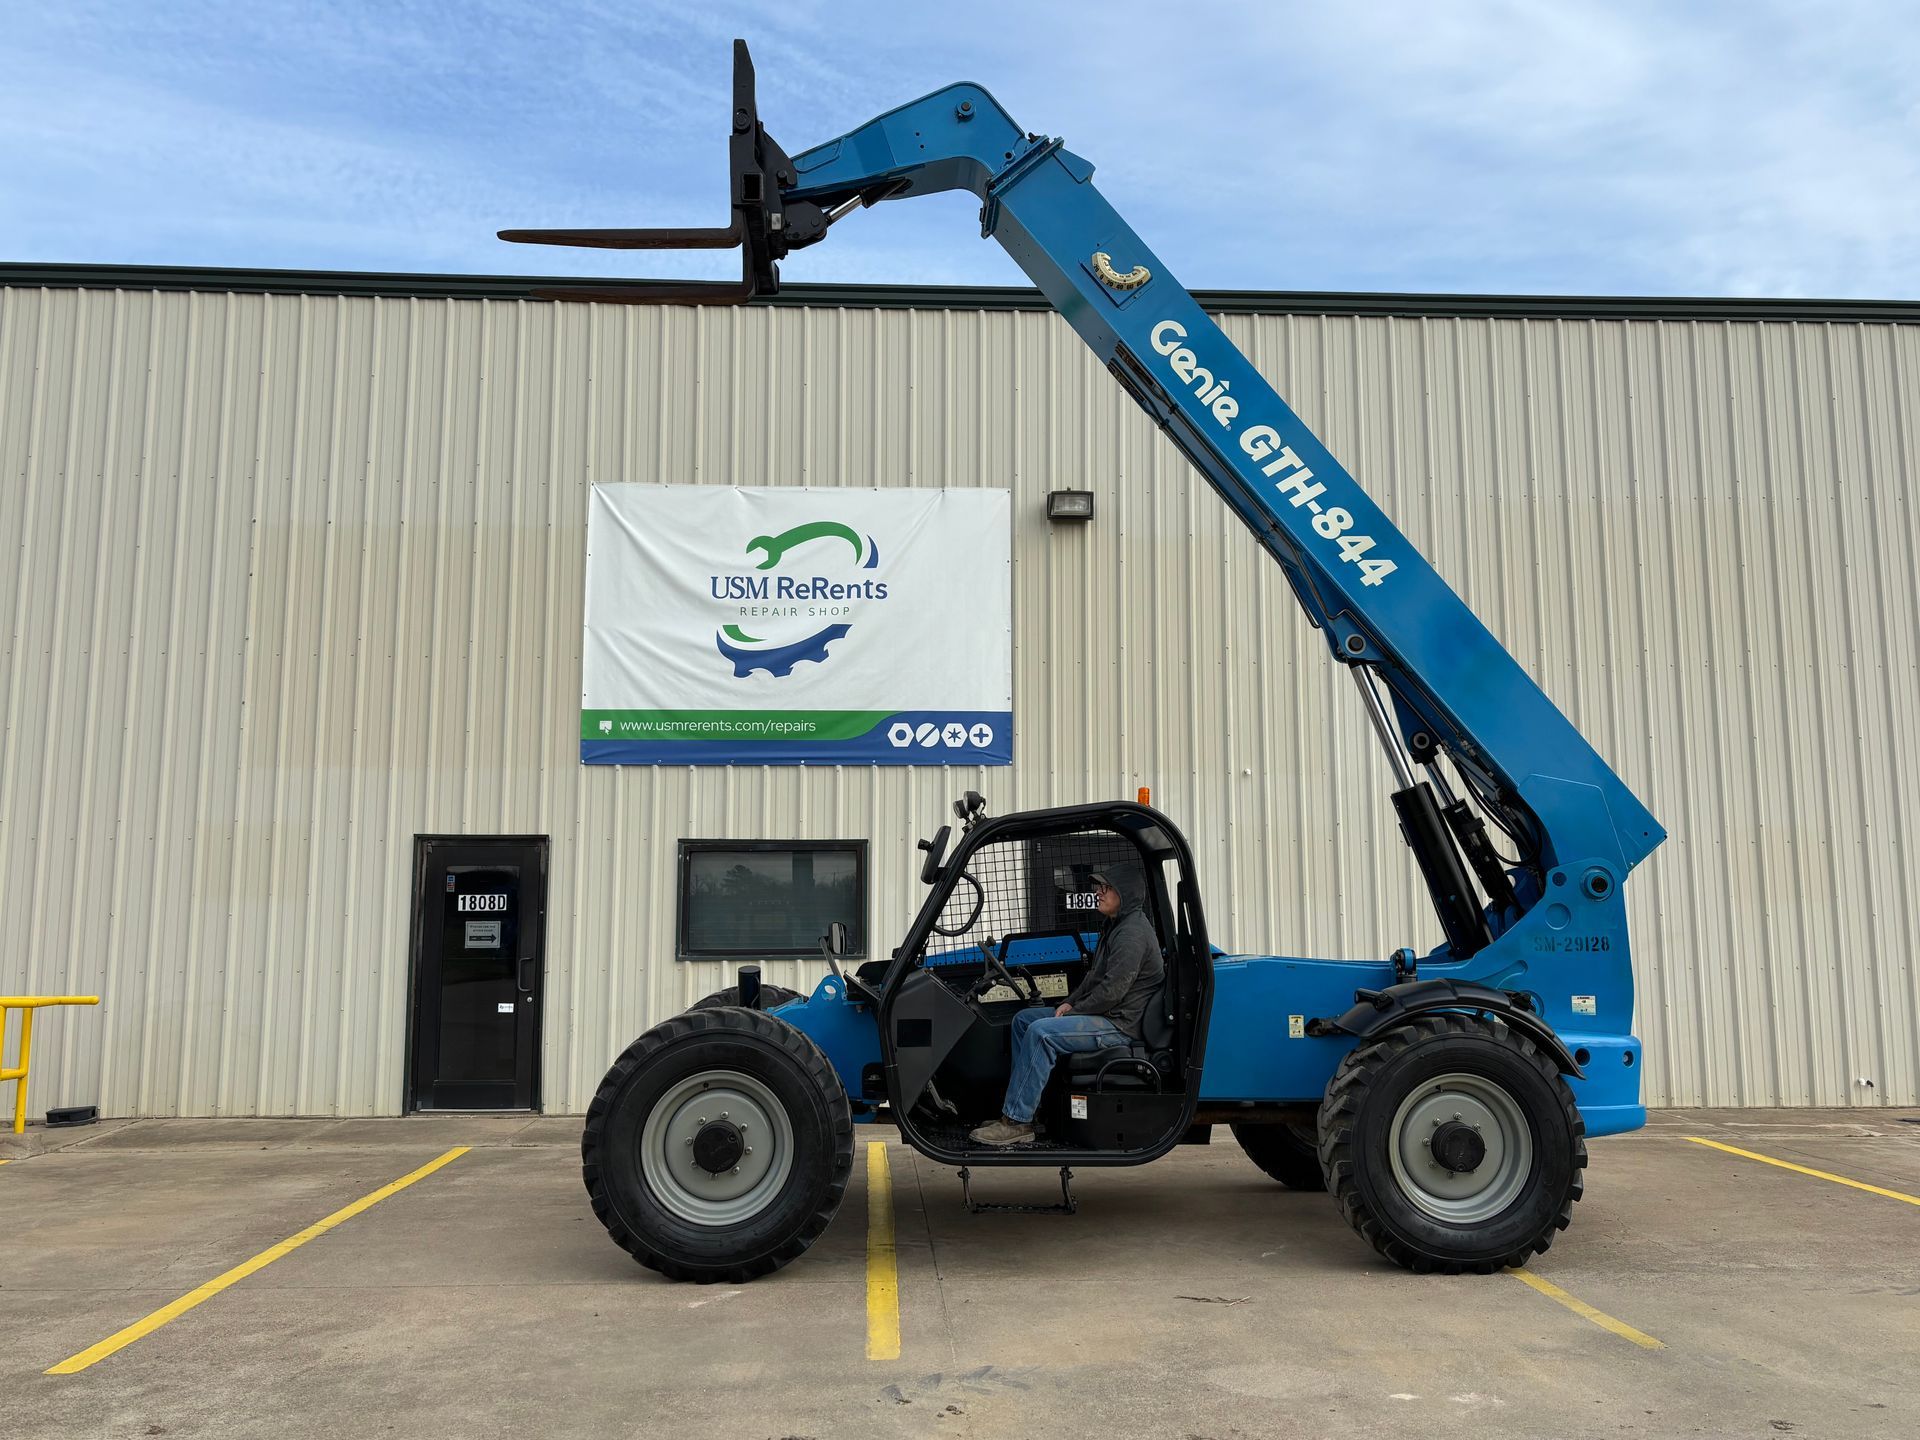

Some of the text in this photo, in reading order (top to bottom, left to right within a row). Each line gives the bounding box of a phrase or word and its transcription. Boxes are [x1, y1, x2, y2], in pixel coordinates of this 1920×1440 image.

[1150, 320, 1398, 587] Genie GTH-844
[711, 576, 888, 600] USM ReRents
[740, 606, 850, 617] REPAIR SHOP
[620, 719, 816, 734] www.usmrerents.com/repairs
[460, 895, 506, 911] 1808D
[1533, 935, 1610, 952] SM-29128
